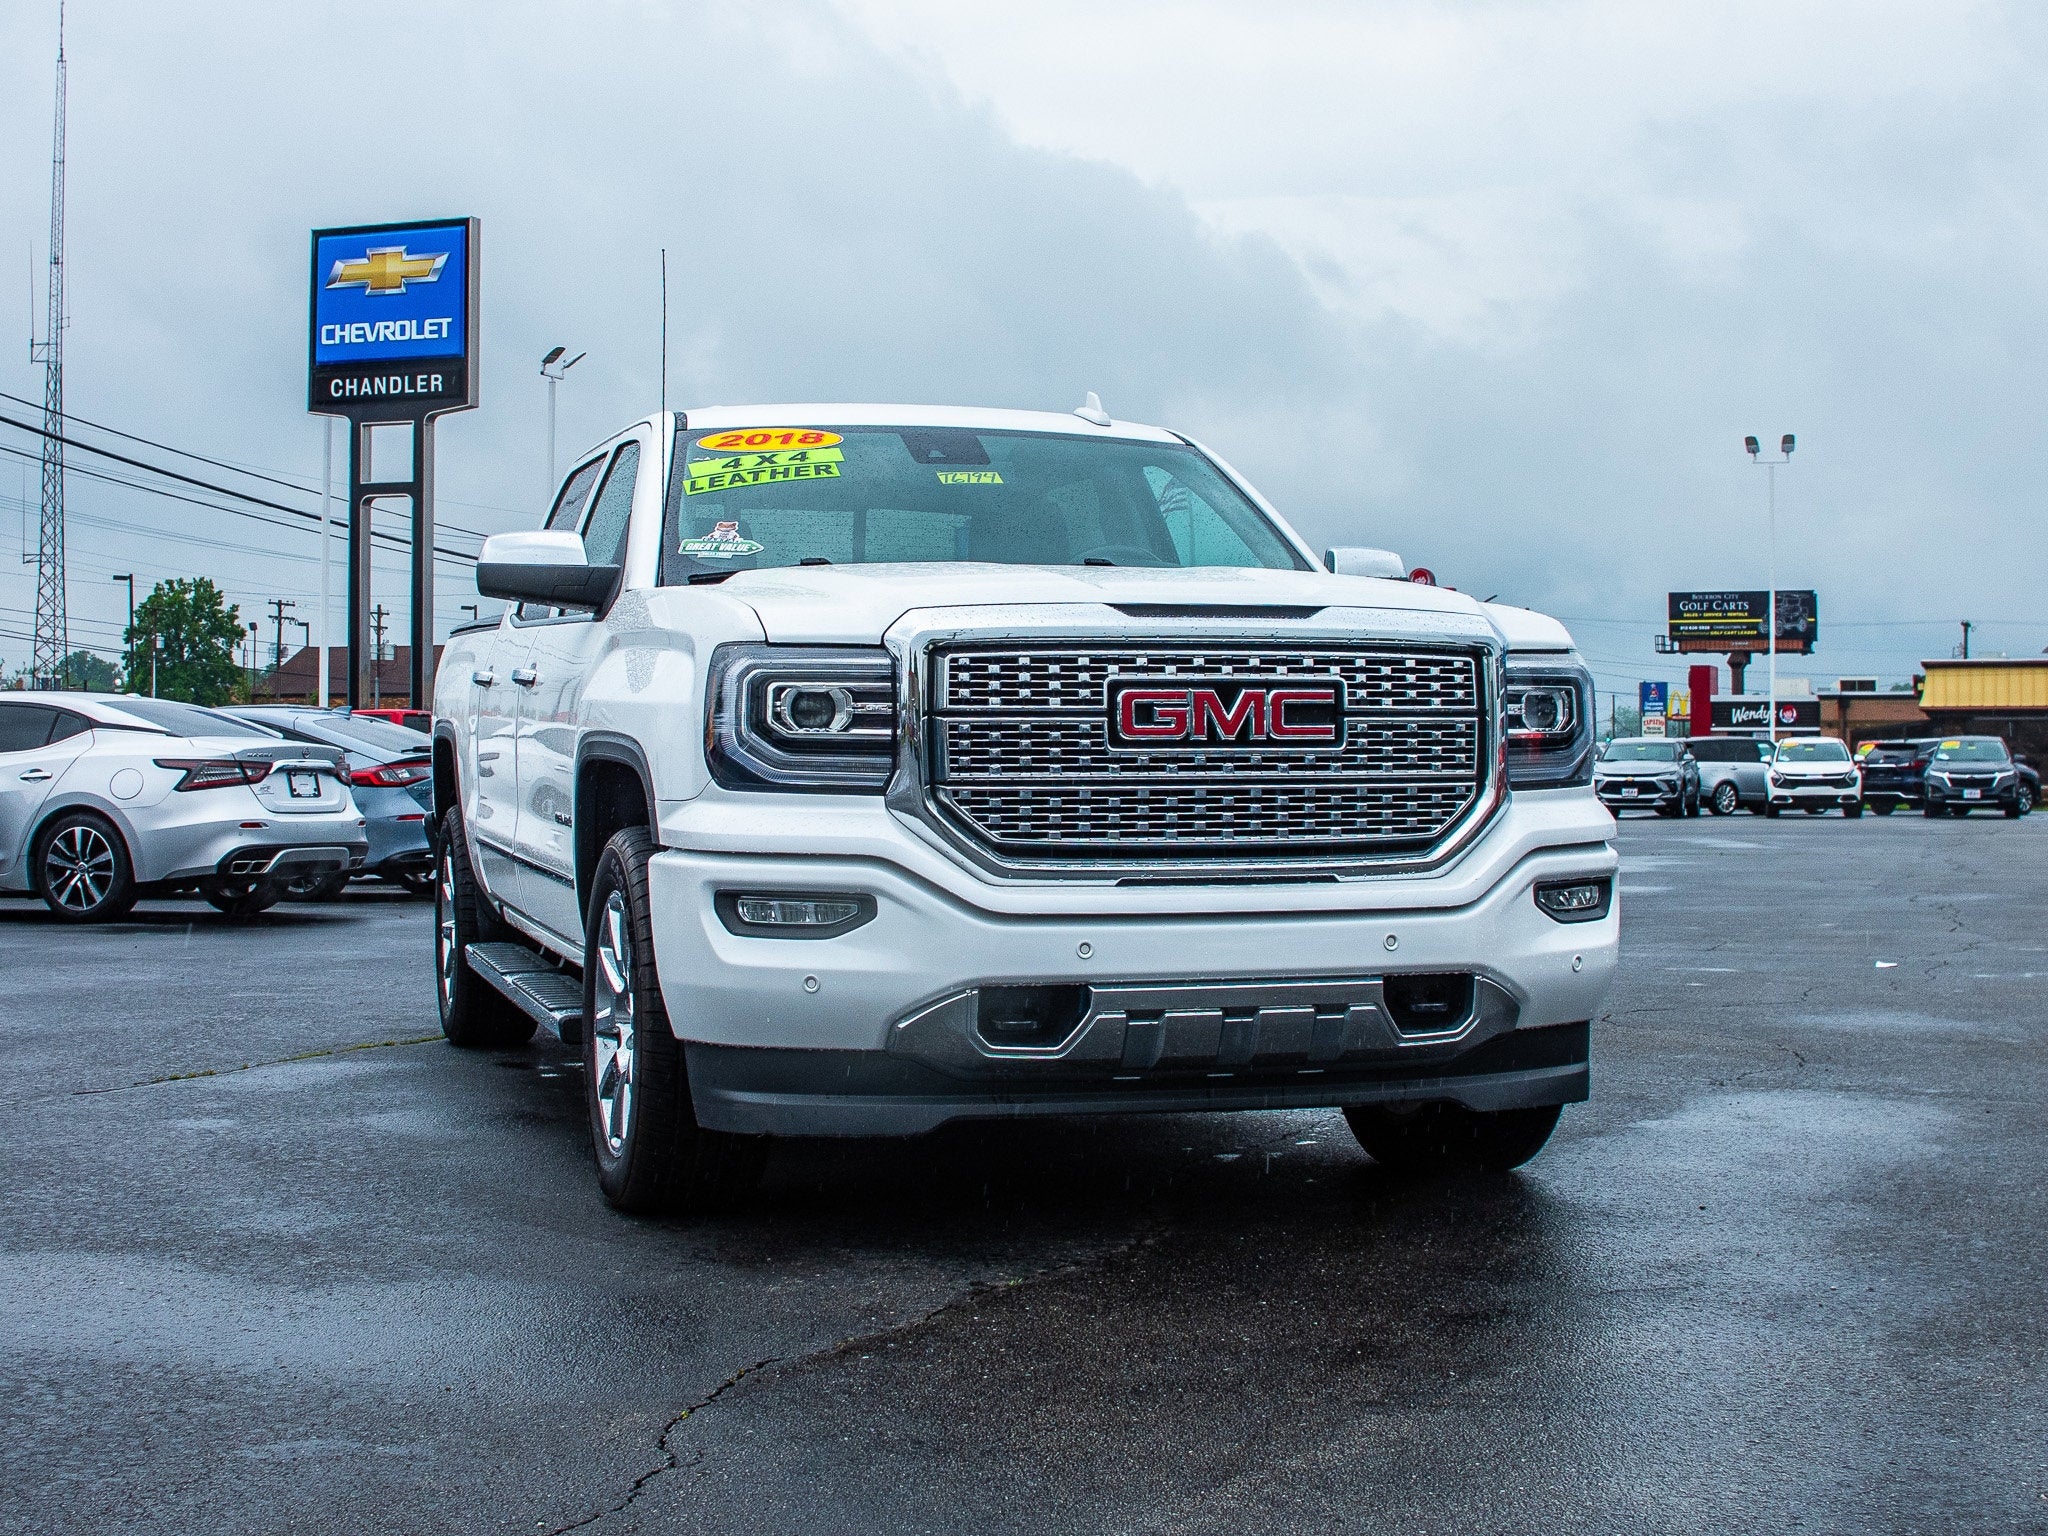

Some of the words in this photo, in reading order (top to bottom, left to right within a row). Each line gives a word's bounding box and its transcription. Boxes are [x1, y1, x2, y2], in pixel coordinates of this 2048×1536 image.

[321, 317, 452, 345] CHEVROLET
[330, 374, 443, 397] CHANDLER
[714, 432, 825, 449] 2018
[721, 457, 743, 470] 4
[754, 453, 779, 467] X
[789, 451, 809, 463] 4
[689, 464, 834, 493] LEATHER
[685, 542, 719, 552] GREAT
[720, 543, 753, 553] VALUE
[1679, 600, 1709, 611] GOLF
[1712, 600, 1749, 611] CARTS
[1723, 592, 1740, 601] CITY
[1117, 688, 1336, 740] GMC
[1731, 704, 1778, 724] Wendy
